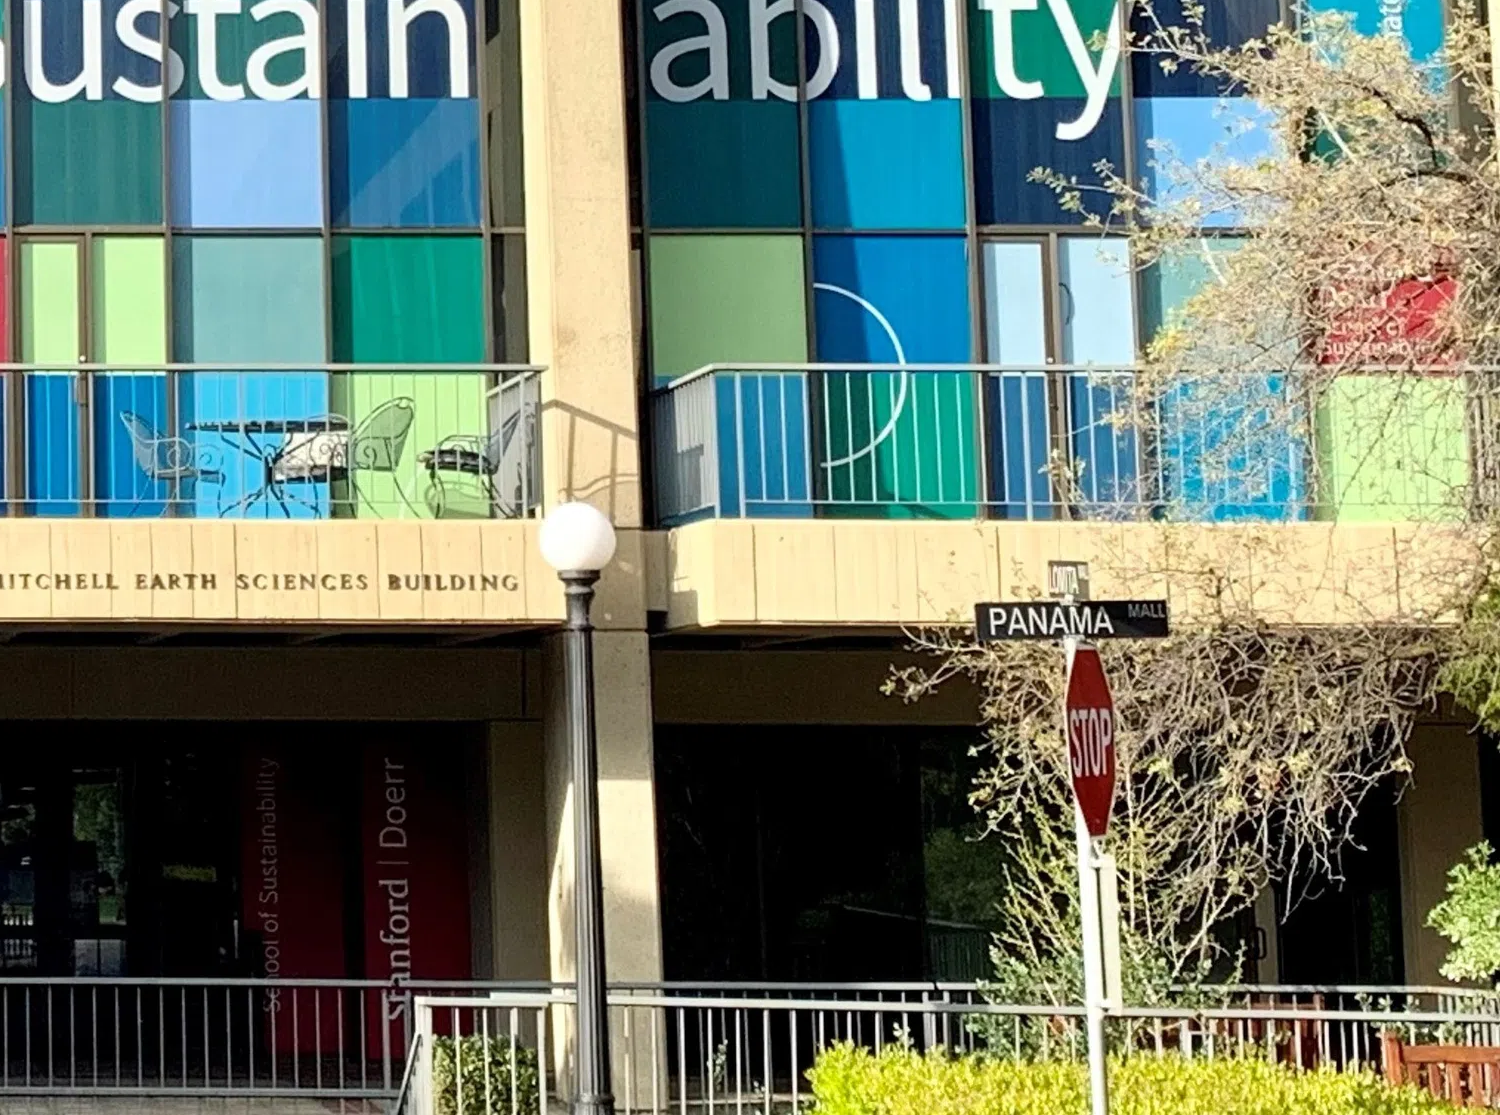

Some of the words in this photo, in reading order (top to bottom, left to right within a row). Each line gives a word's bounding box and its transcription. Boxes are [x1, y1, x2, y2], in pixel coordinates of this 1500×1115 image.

[135, 573, 217, 591] EARTH
[235, 573, 368, 591] SCIENCES
[388, 573, 519, 591] BUILDING
[988, 605, 1114, 636] PANAMA
[1127, 602, 1167, 619] MALL
[1069, 707, 1113, 778] STOP
[378, 757, 408, 849] Doerr
[256, 757, 280, 904] Sustainability
[257, 911, 280, 934] of
